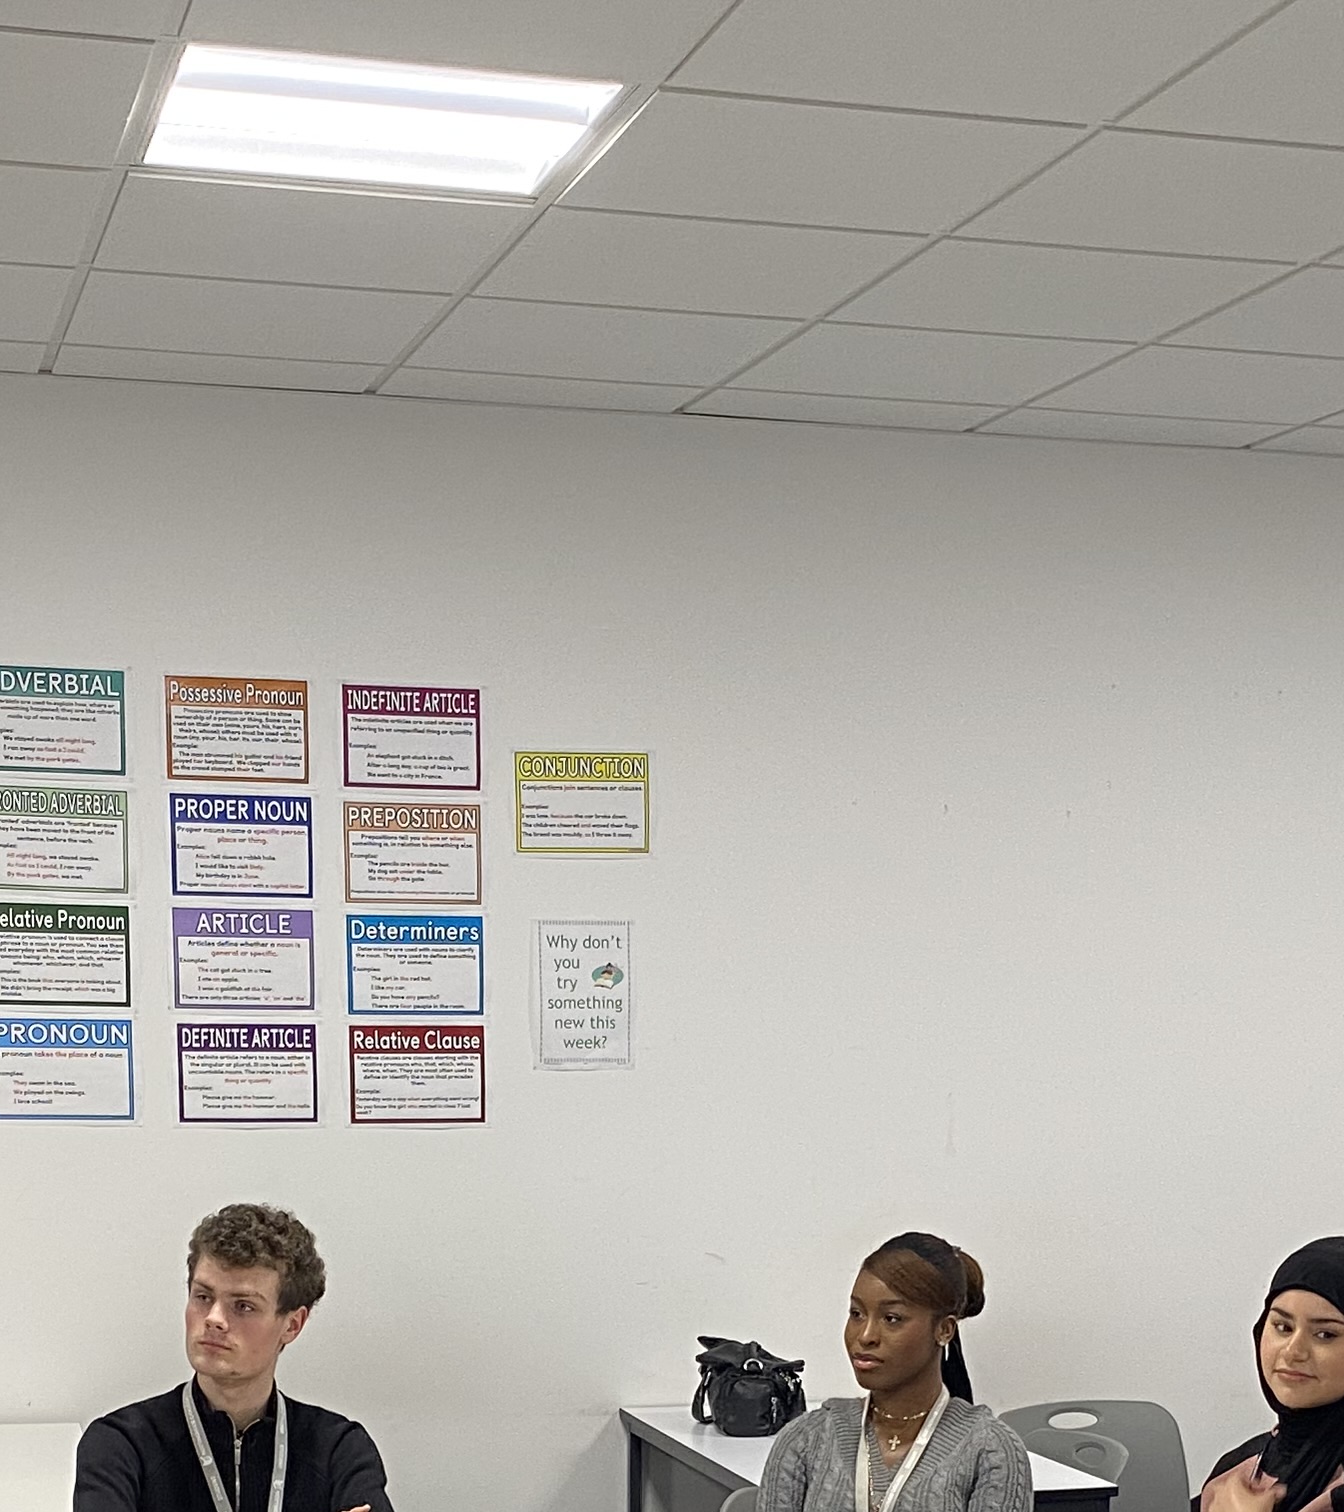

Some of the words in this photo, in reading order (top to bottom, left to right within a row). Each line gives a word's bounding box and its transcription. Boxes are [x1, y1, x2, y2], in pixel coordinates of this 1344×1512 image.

[170, 681, 242, 703] Possessive
[246, 684, 303, 706] Pronoun
[347, 690, 420, 712] INDEFINITE
[423, 692, 476, 713] ARTICLE
[520, 757, 644, 778] CONJUNCTION
[50, 792, 123, 815] ADVERBIAL
[175, 798, 248, 820] PROPER
[254, 800, 307, 822] NOUN
[348, 807, 476, 829] PREPOSITION
[58, 910, 125, 930] Pronoun
[196, 913, 291, 934] ARTICLE
[351, 920, 479, 940] Determiners
[546, 934, 578, 952] Why
[582, 935, 622, 949] don't
[554, 958, 580, 972] you
[557, 977, 578, 992] try
[547, 996, 623, 1012] something
[554, 1018, 585, 1029] new
[590, 1015, 616, 1029] this
[182, 1028, 248, 1048] DEFINITE
[251, 1028, 311, 1048] ARTICLE
[353, 1030, 420, 1049] Relative
[424, 1030, 480, 1049] Clause
[564, 1036, 608, 1049] week?
